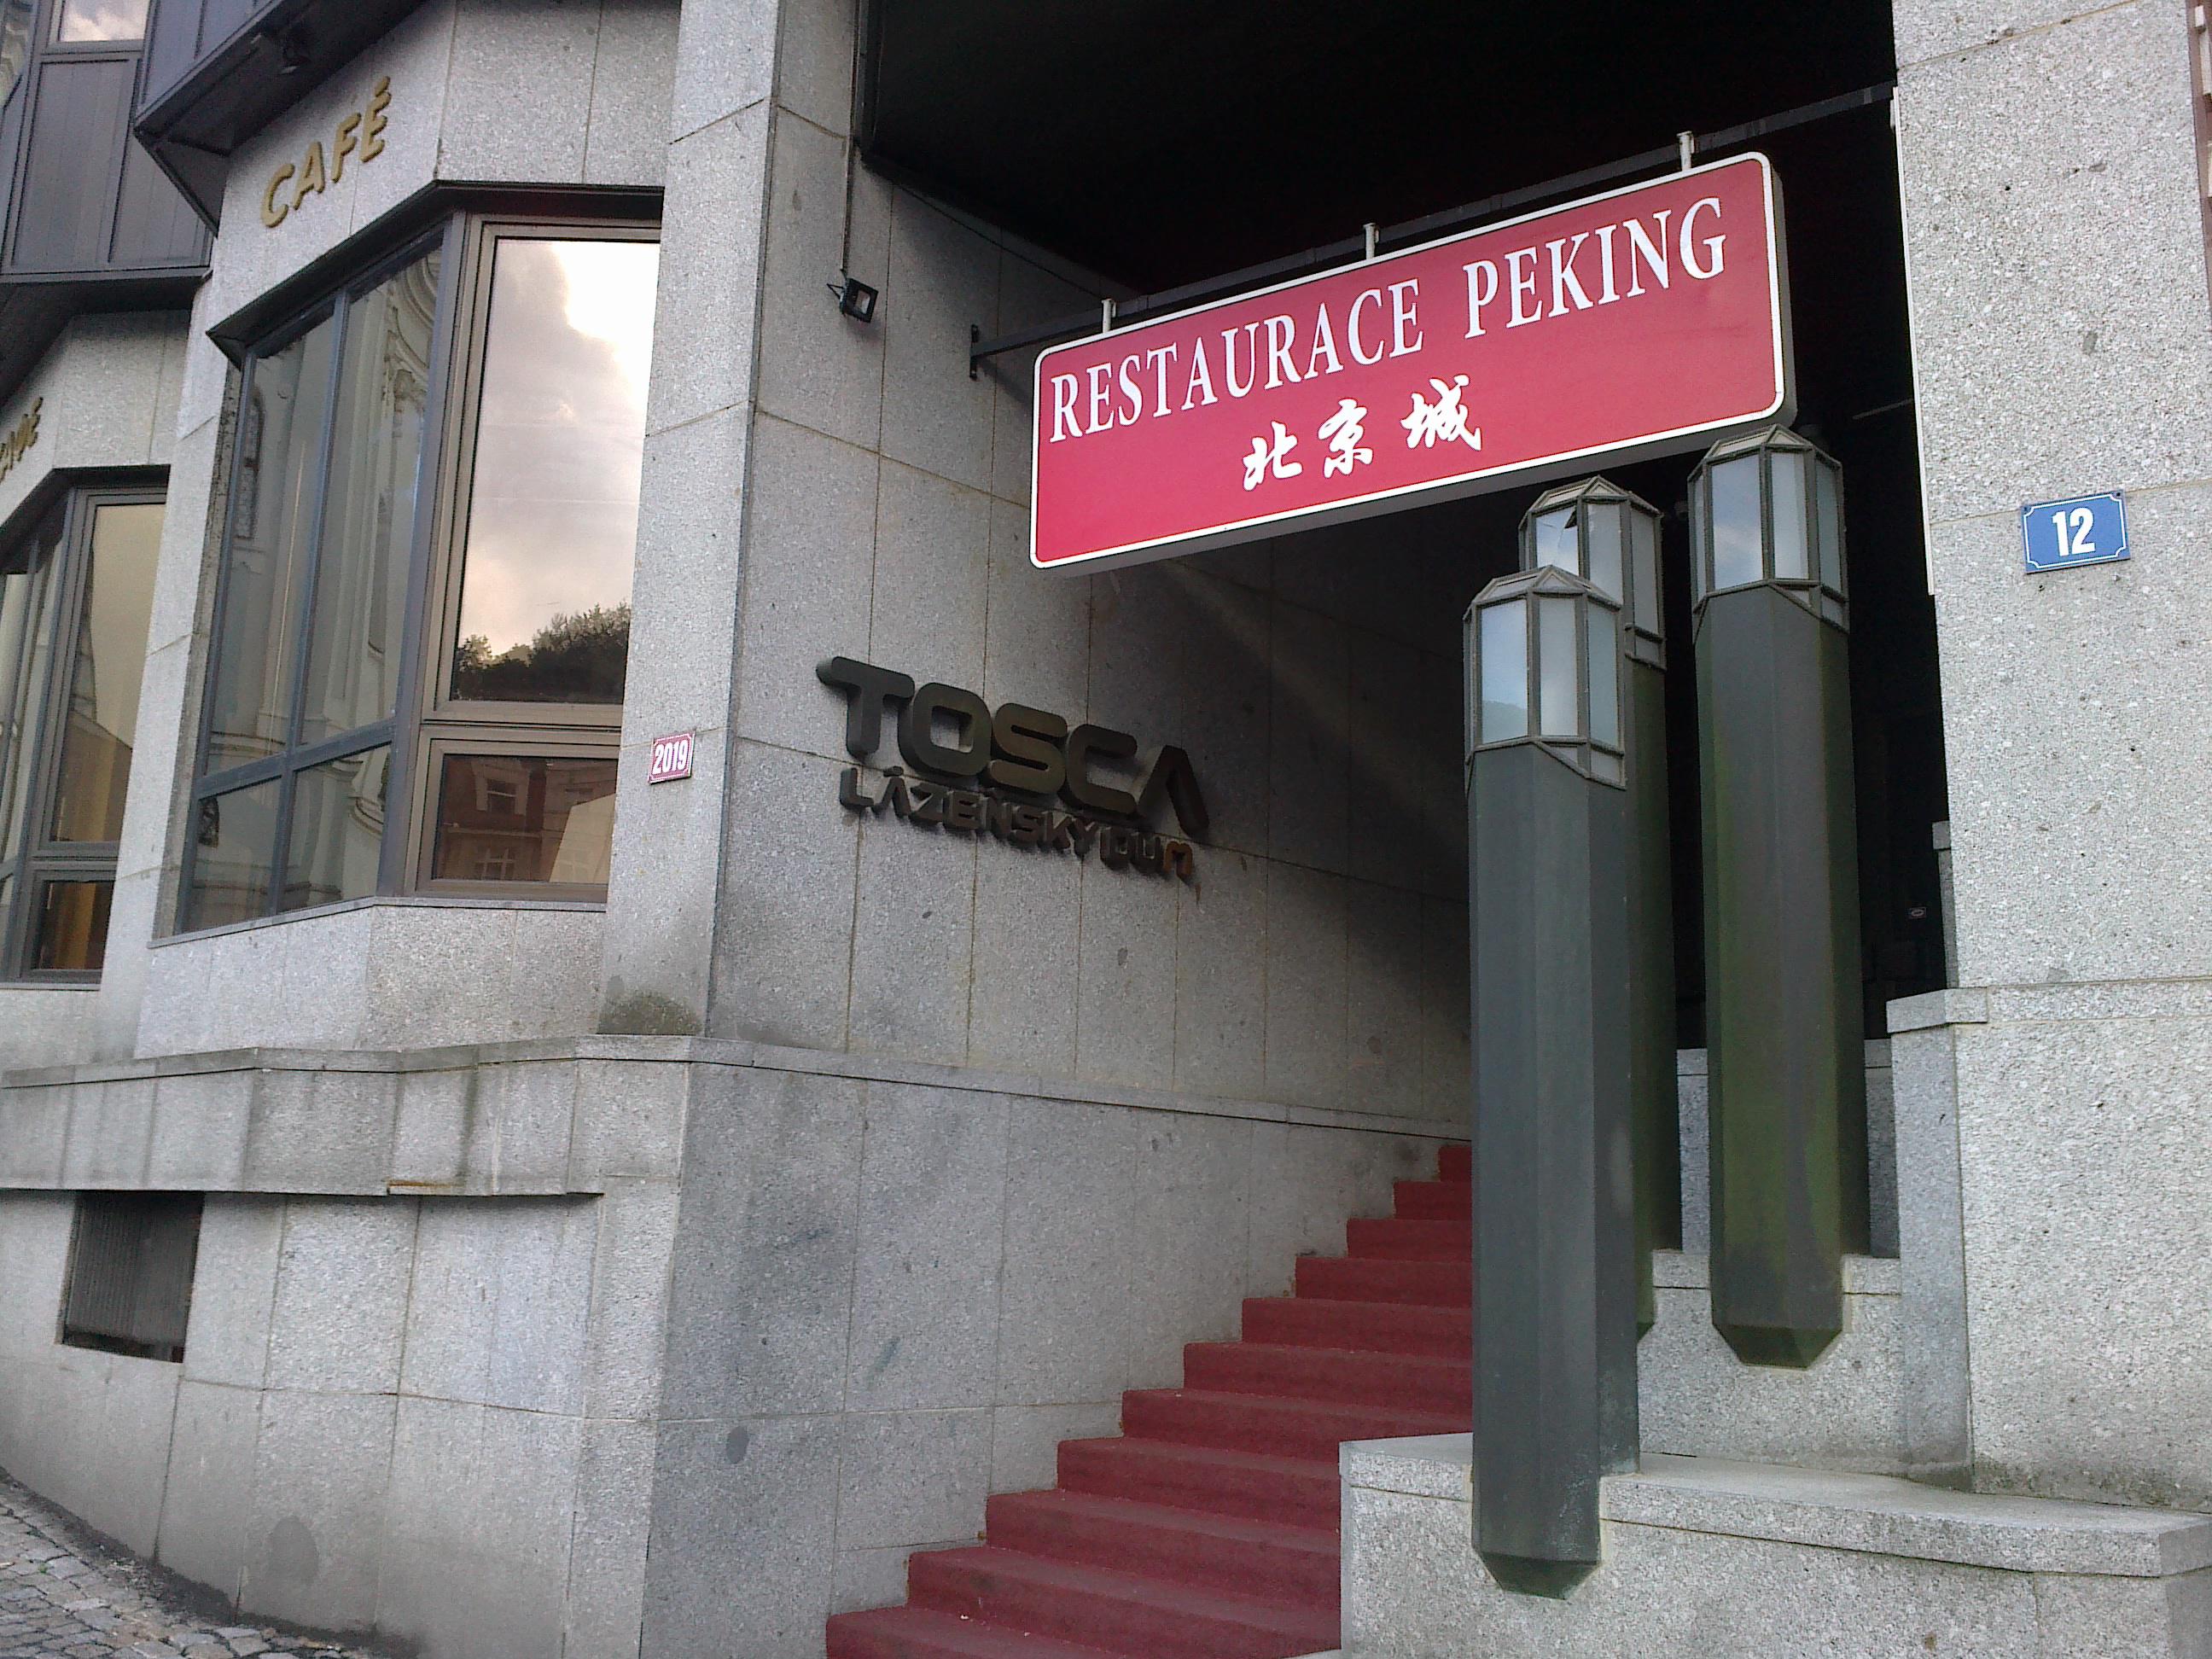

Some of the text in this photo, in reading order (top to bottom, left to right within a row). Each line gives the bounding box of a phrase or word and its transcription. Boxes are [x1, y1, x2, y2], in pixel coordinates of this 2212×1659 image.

[260, 76, 392, 228] CAFÉ
[1050, 196, 1726, 444] RESTAURACE PEKING
[1242, 374, 1483, 492] 北京城
[2052, 508, 2096, 556] 12
[652, 739, 689, 775] 2019
[817, 655, 1210, 842] TOSCA
